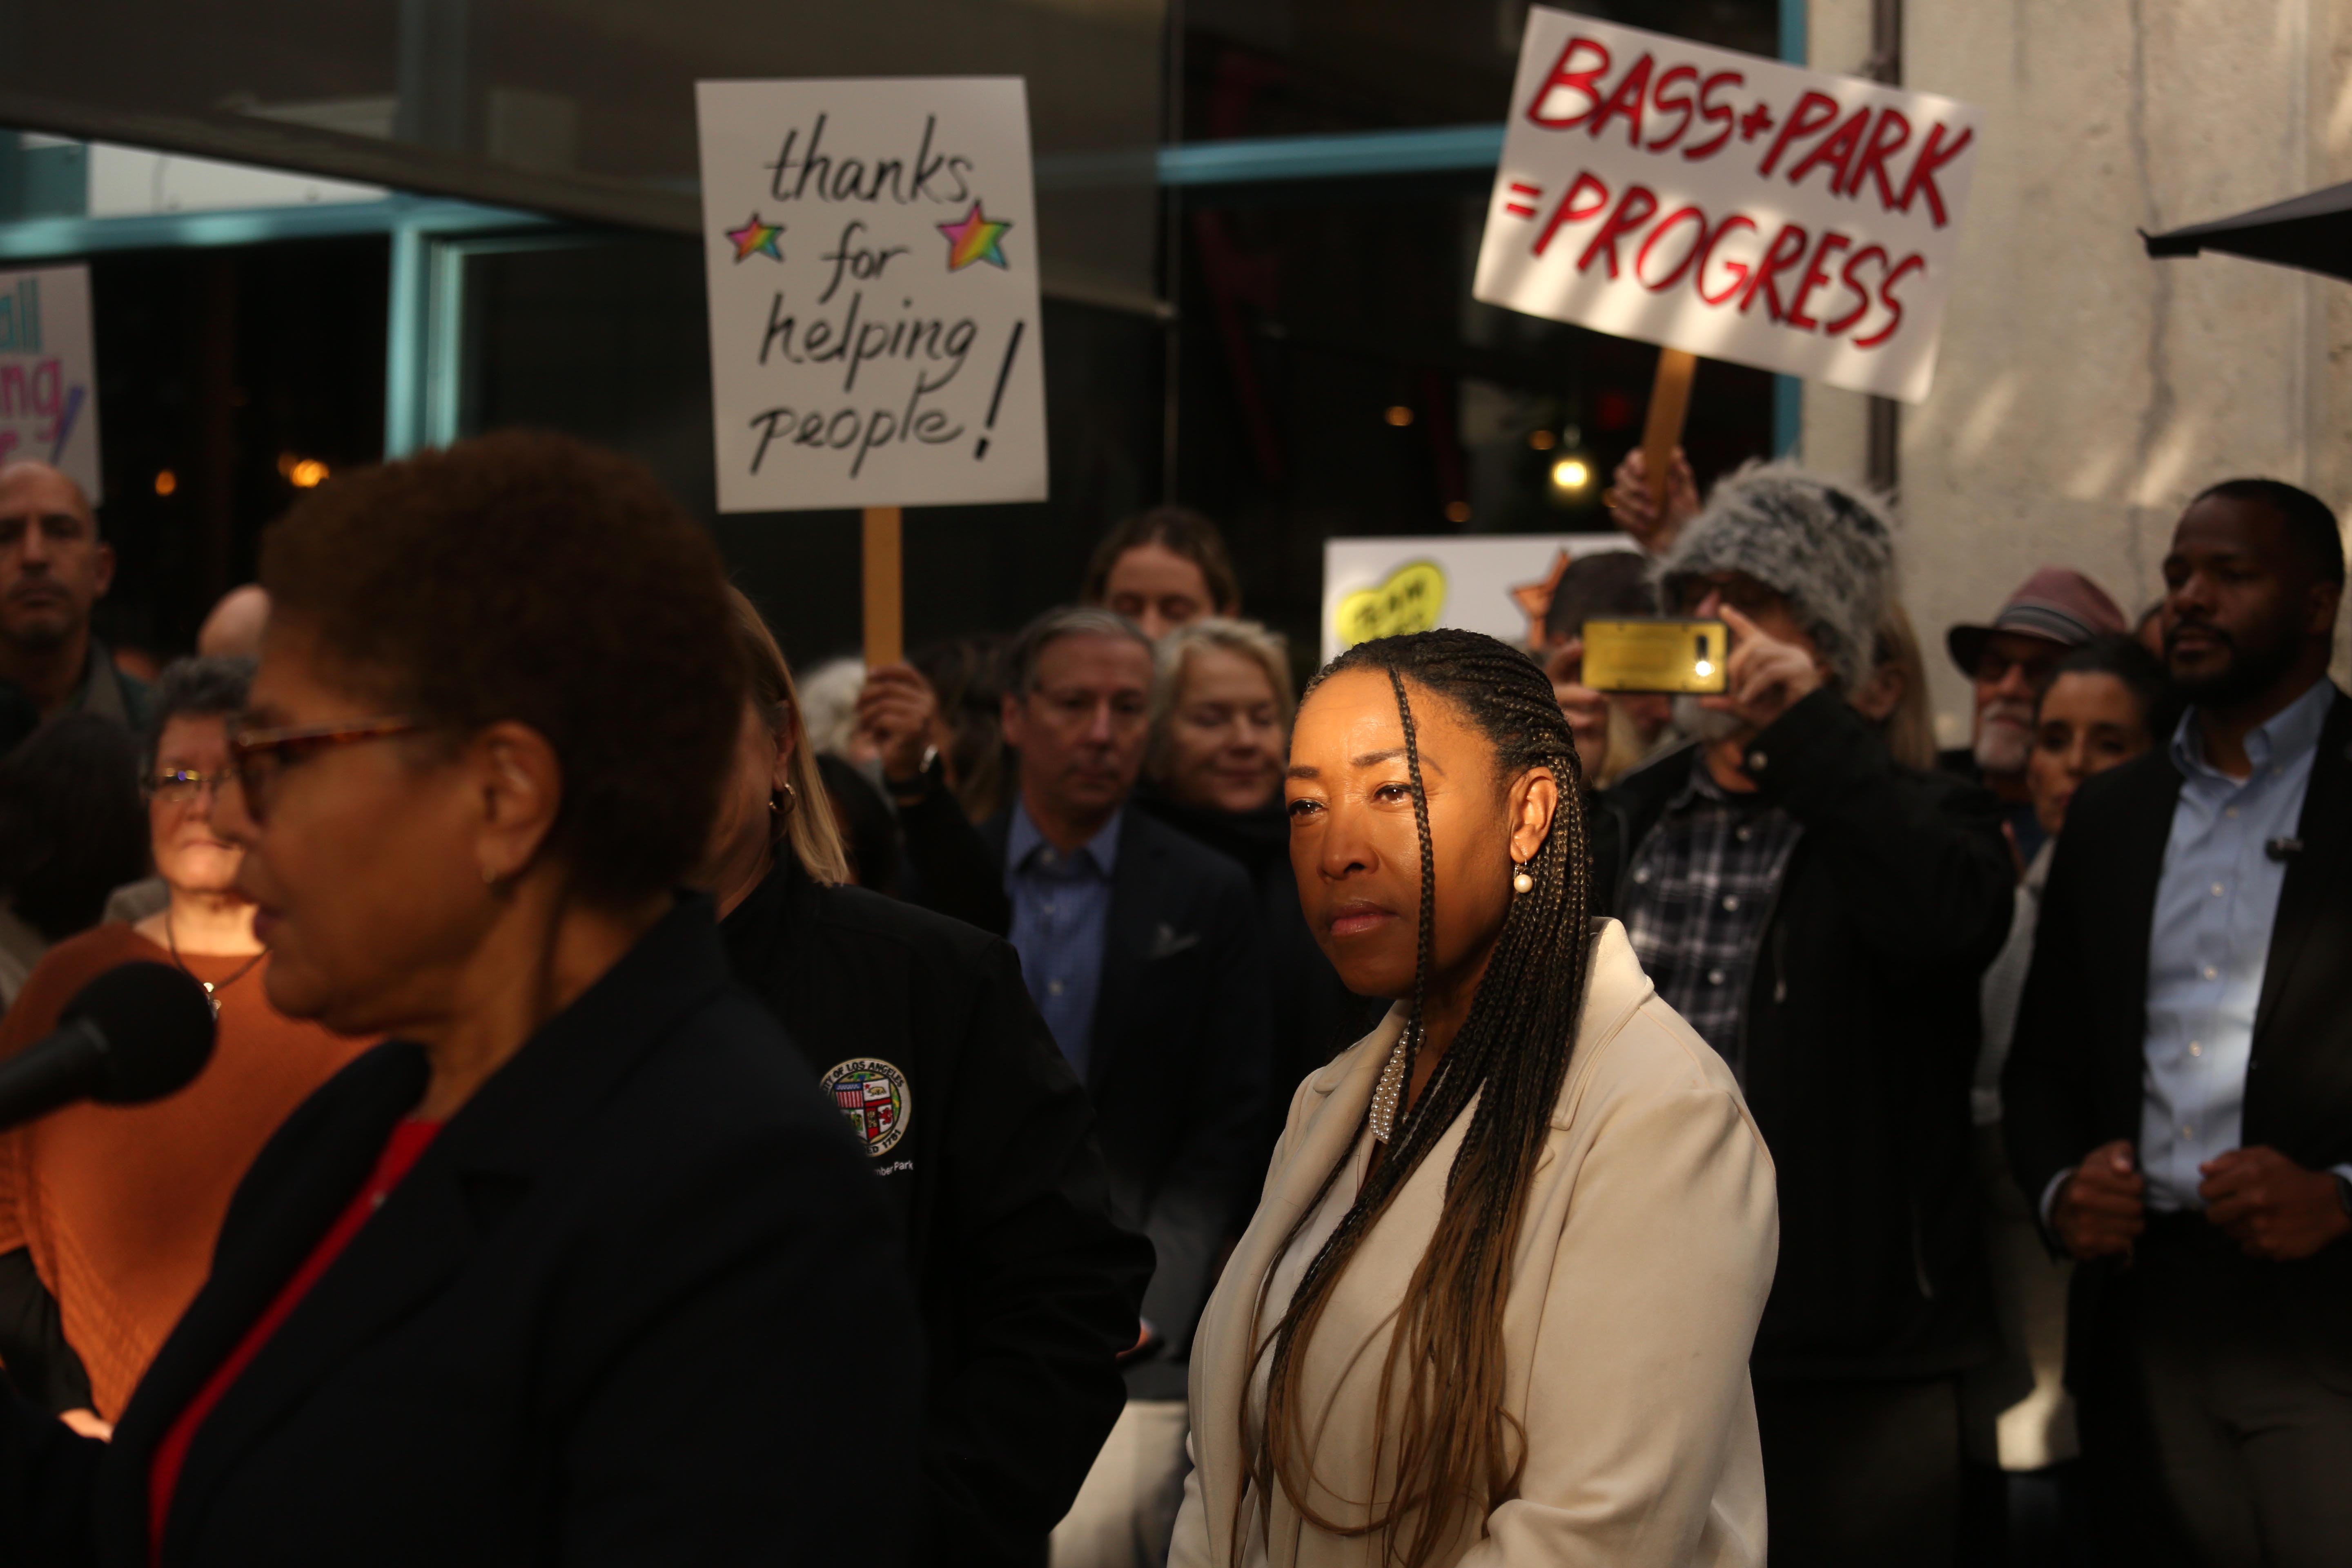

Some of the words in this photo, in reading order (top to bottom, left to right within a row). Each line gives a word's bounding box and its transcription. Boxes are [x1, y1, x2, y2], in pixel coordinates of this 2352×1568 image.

[763, 112, 974, 203] thanks
[821, 220, 911, 305] for
[759, 291, 978, 393] helping
[822, 1075, 833, 1091] ITY
[833, 1067, 844, 1078] OF
[846, 1061, 866, 1072] LOS
[868, 1062, 904, 1087] ANGELES
[882, 1129, 901, 1148] 1781
